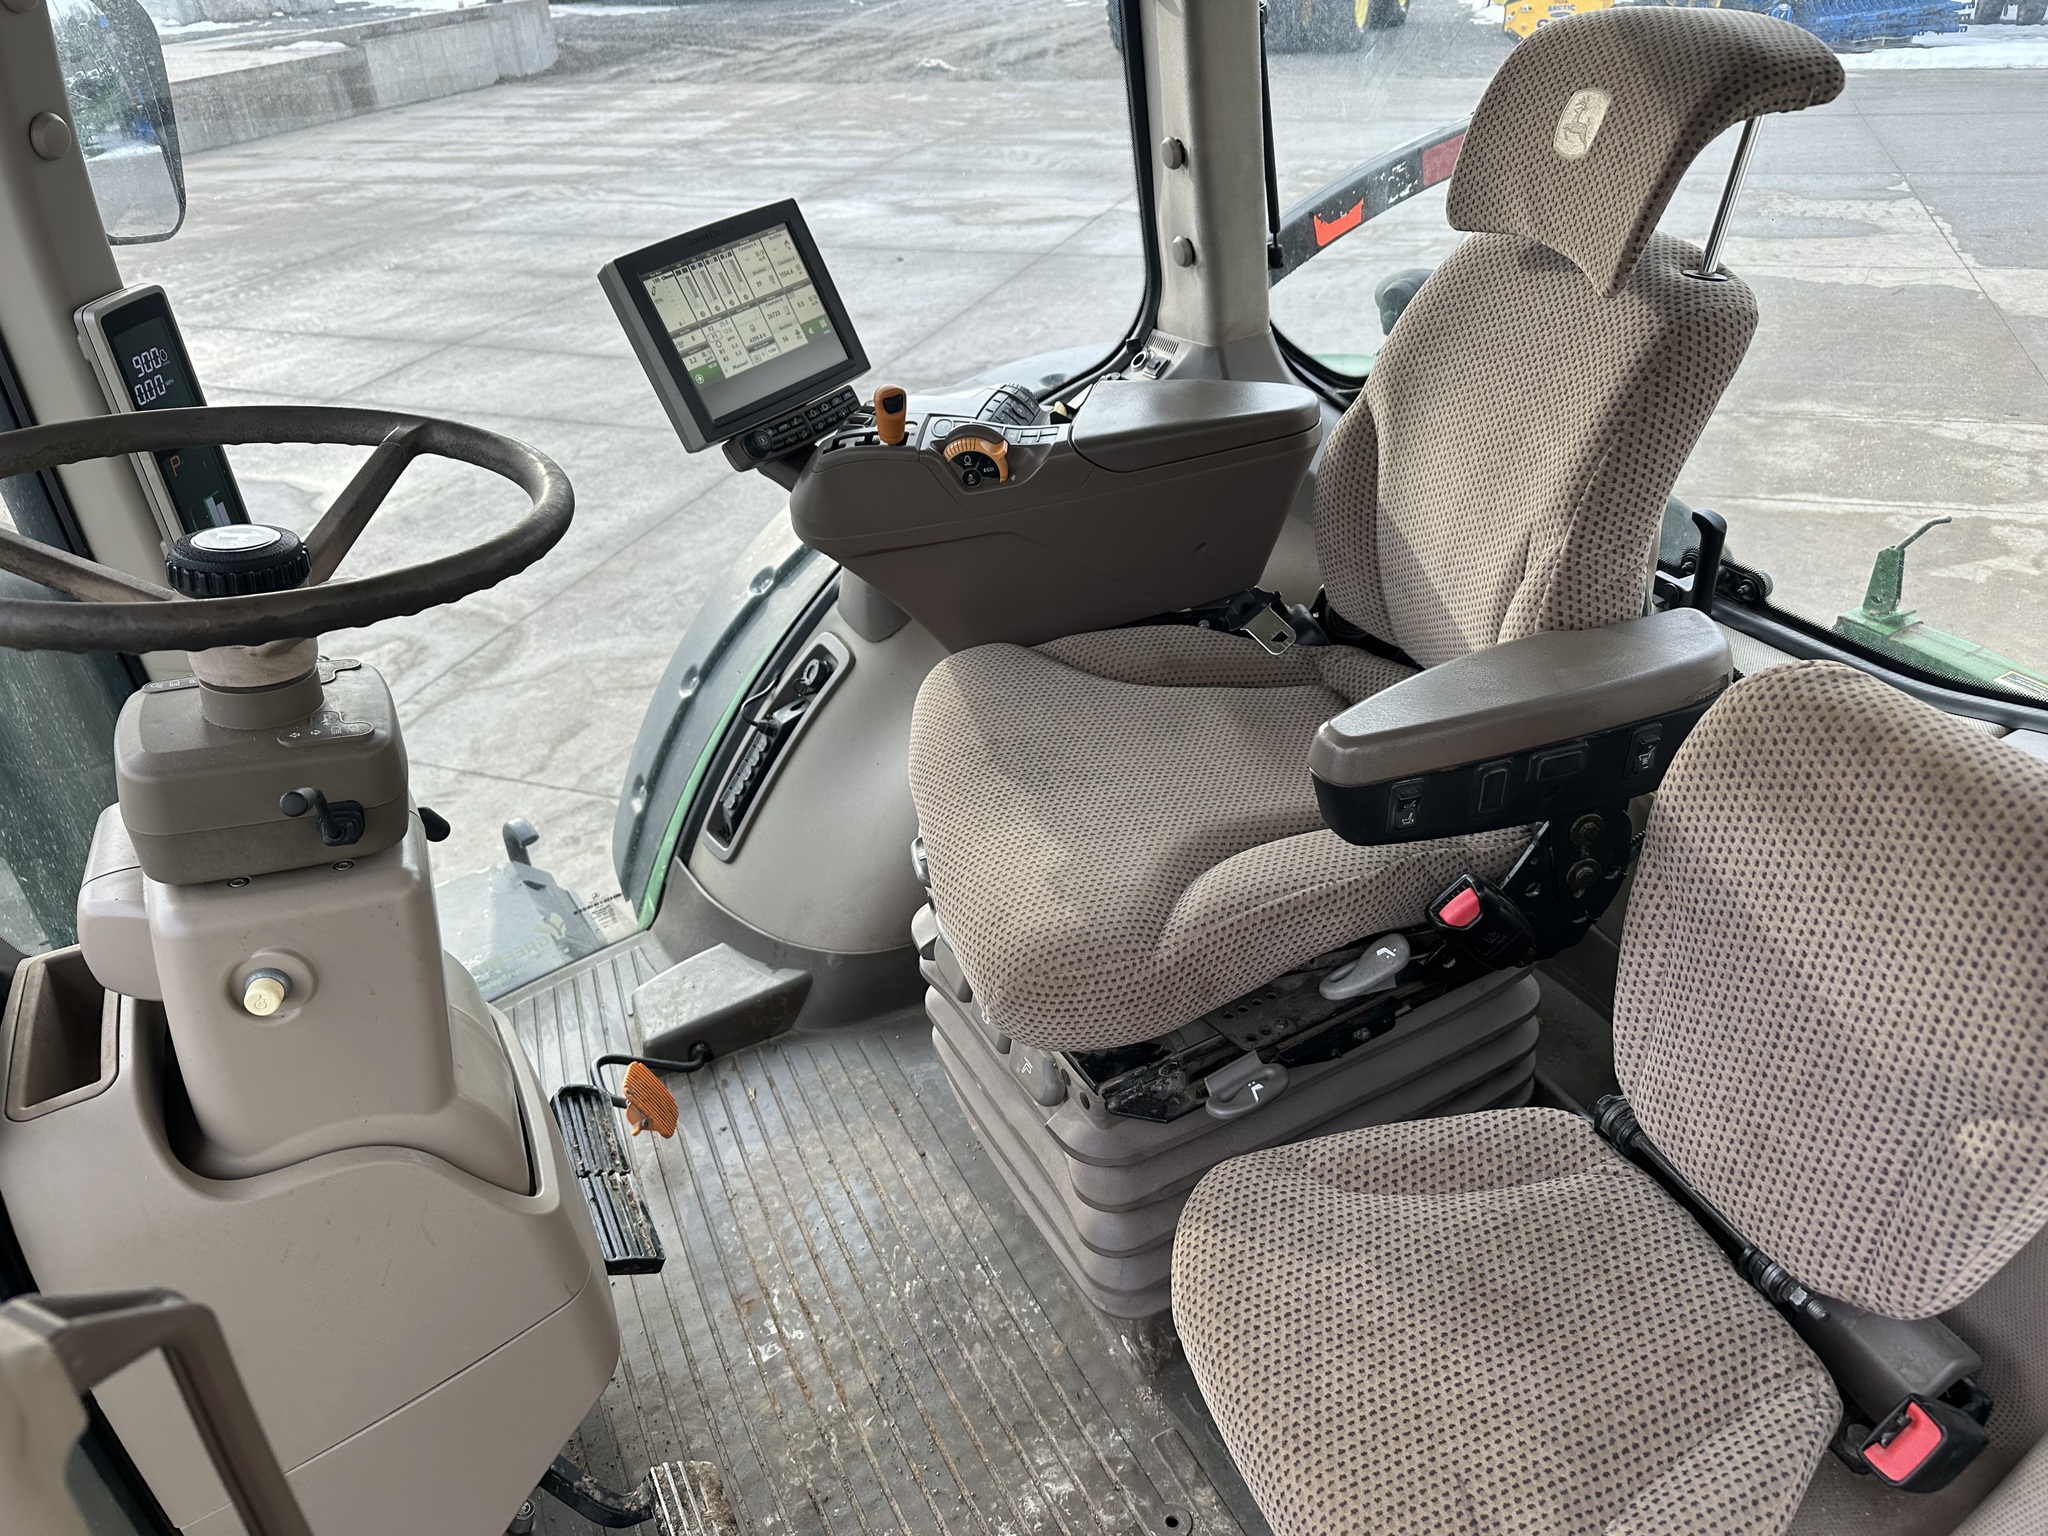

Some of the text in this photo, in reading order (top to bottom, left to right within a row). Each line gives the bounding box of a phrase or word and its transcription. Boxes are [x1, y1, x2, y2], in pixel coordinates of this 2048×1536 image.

[1548, 4, 1576, 12] ARCTIC
[132, 347, 162, 378] 900
[731, 359, 749, 370] Manual
[134, 374, 166, 406] 0.00
[165, 378, 174, 386] MPH
[170, 455, 181, 477] P
